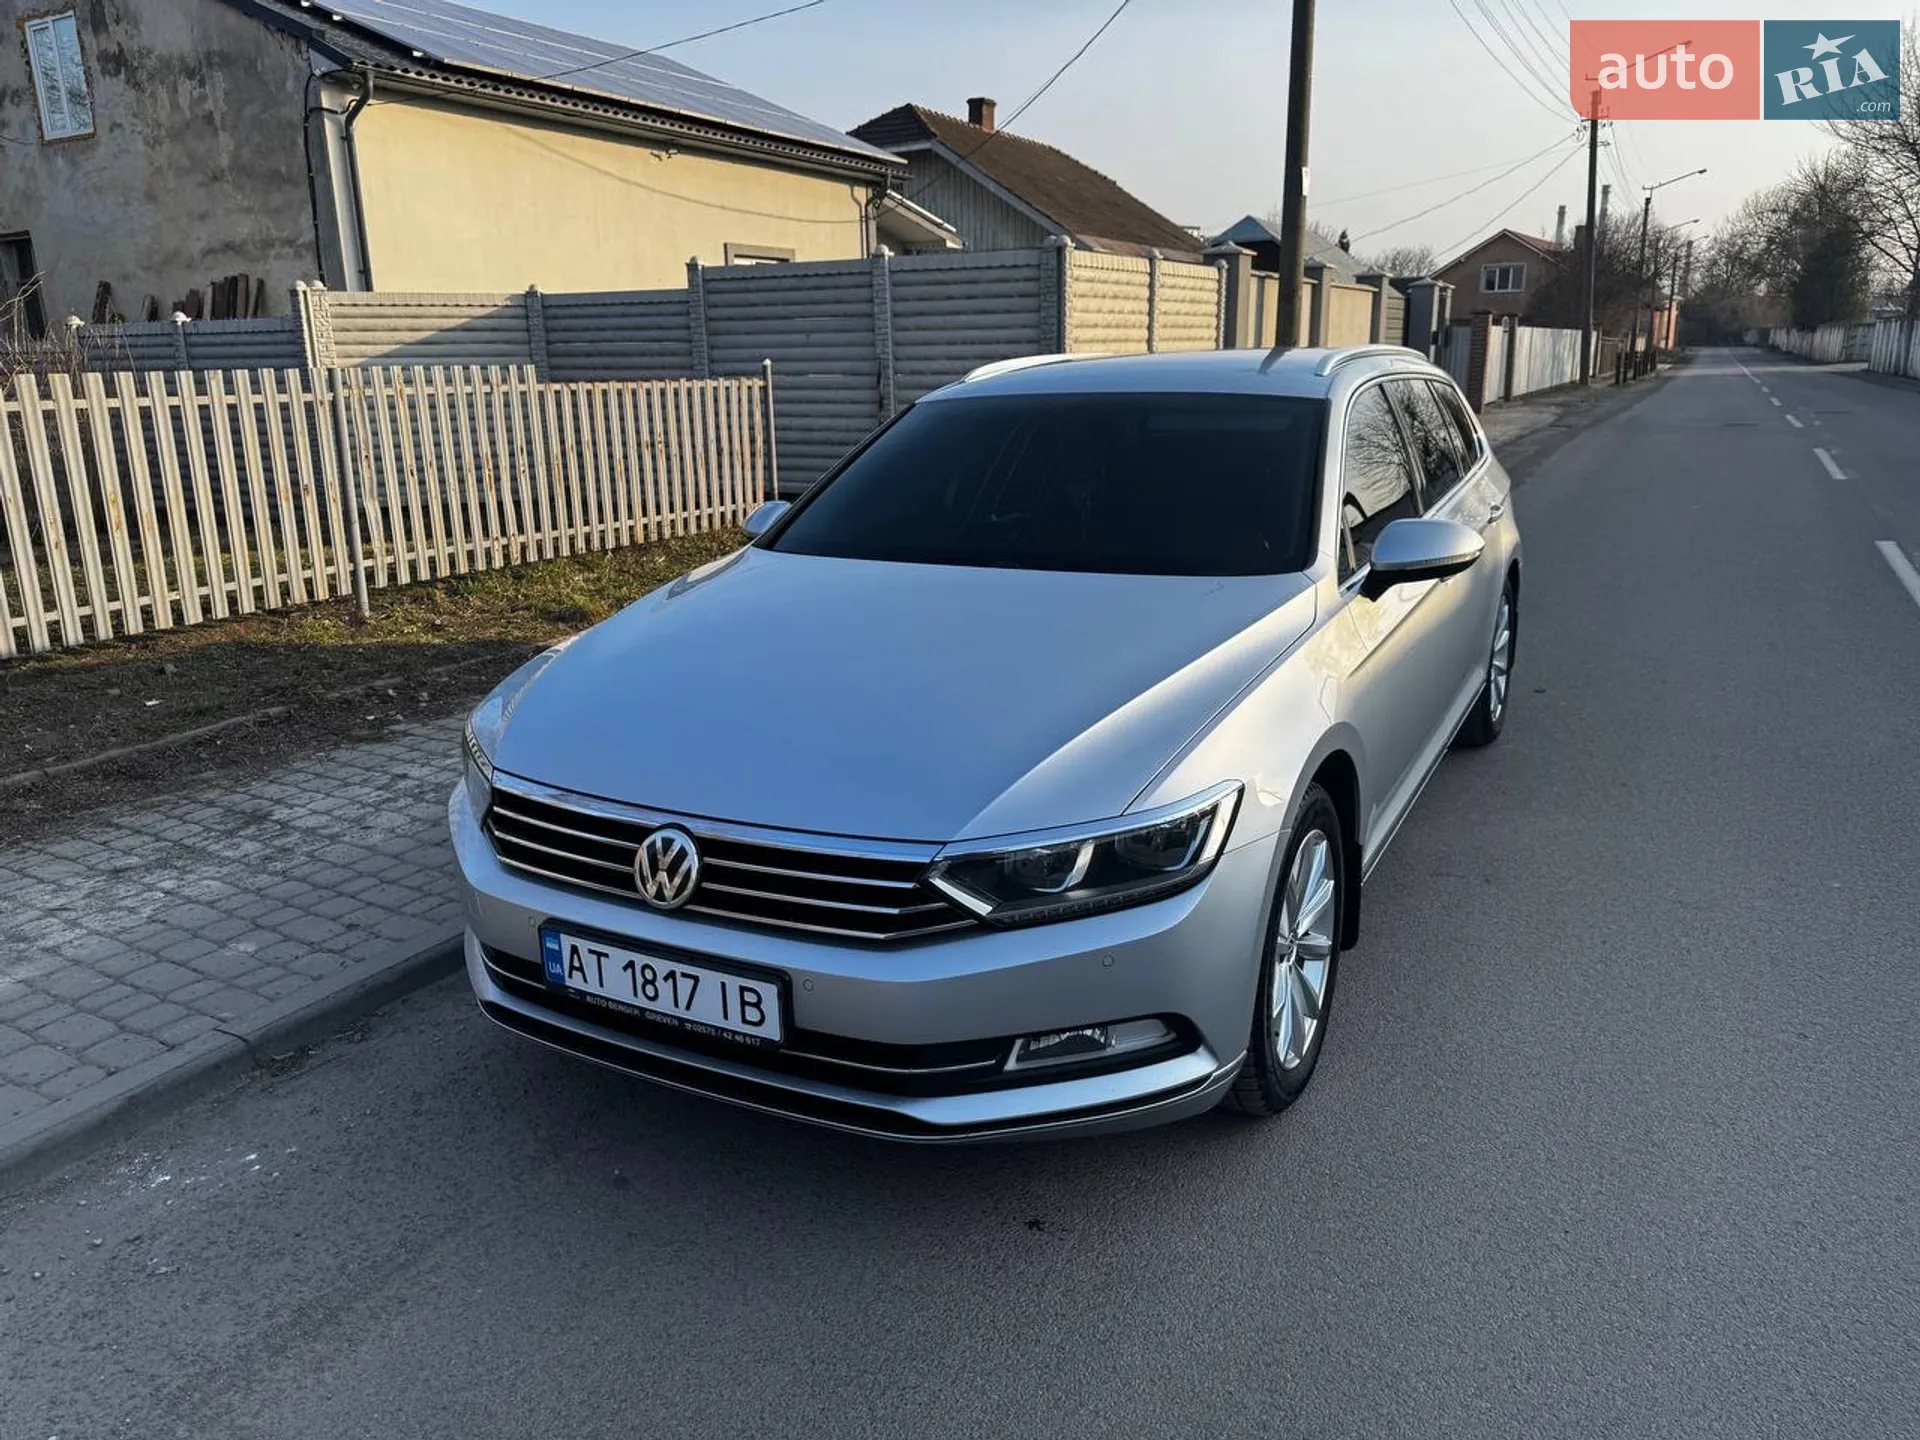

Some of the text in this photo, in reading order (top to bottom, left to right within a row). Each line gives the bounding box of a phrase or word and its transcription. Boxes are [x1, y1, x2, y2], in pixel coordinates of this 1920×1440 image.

[548, 961, 564, 976] UA
[567, 943, 767, 1028] AT 1817 IB
[586, 995, 607, 1008] AUTO
